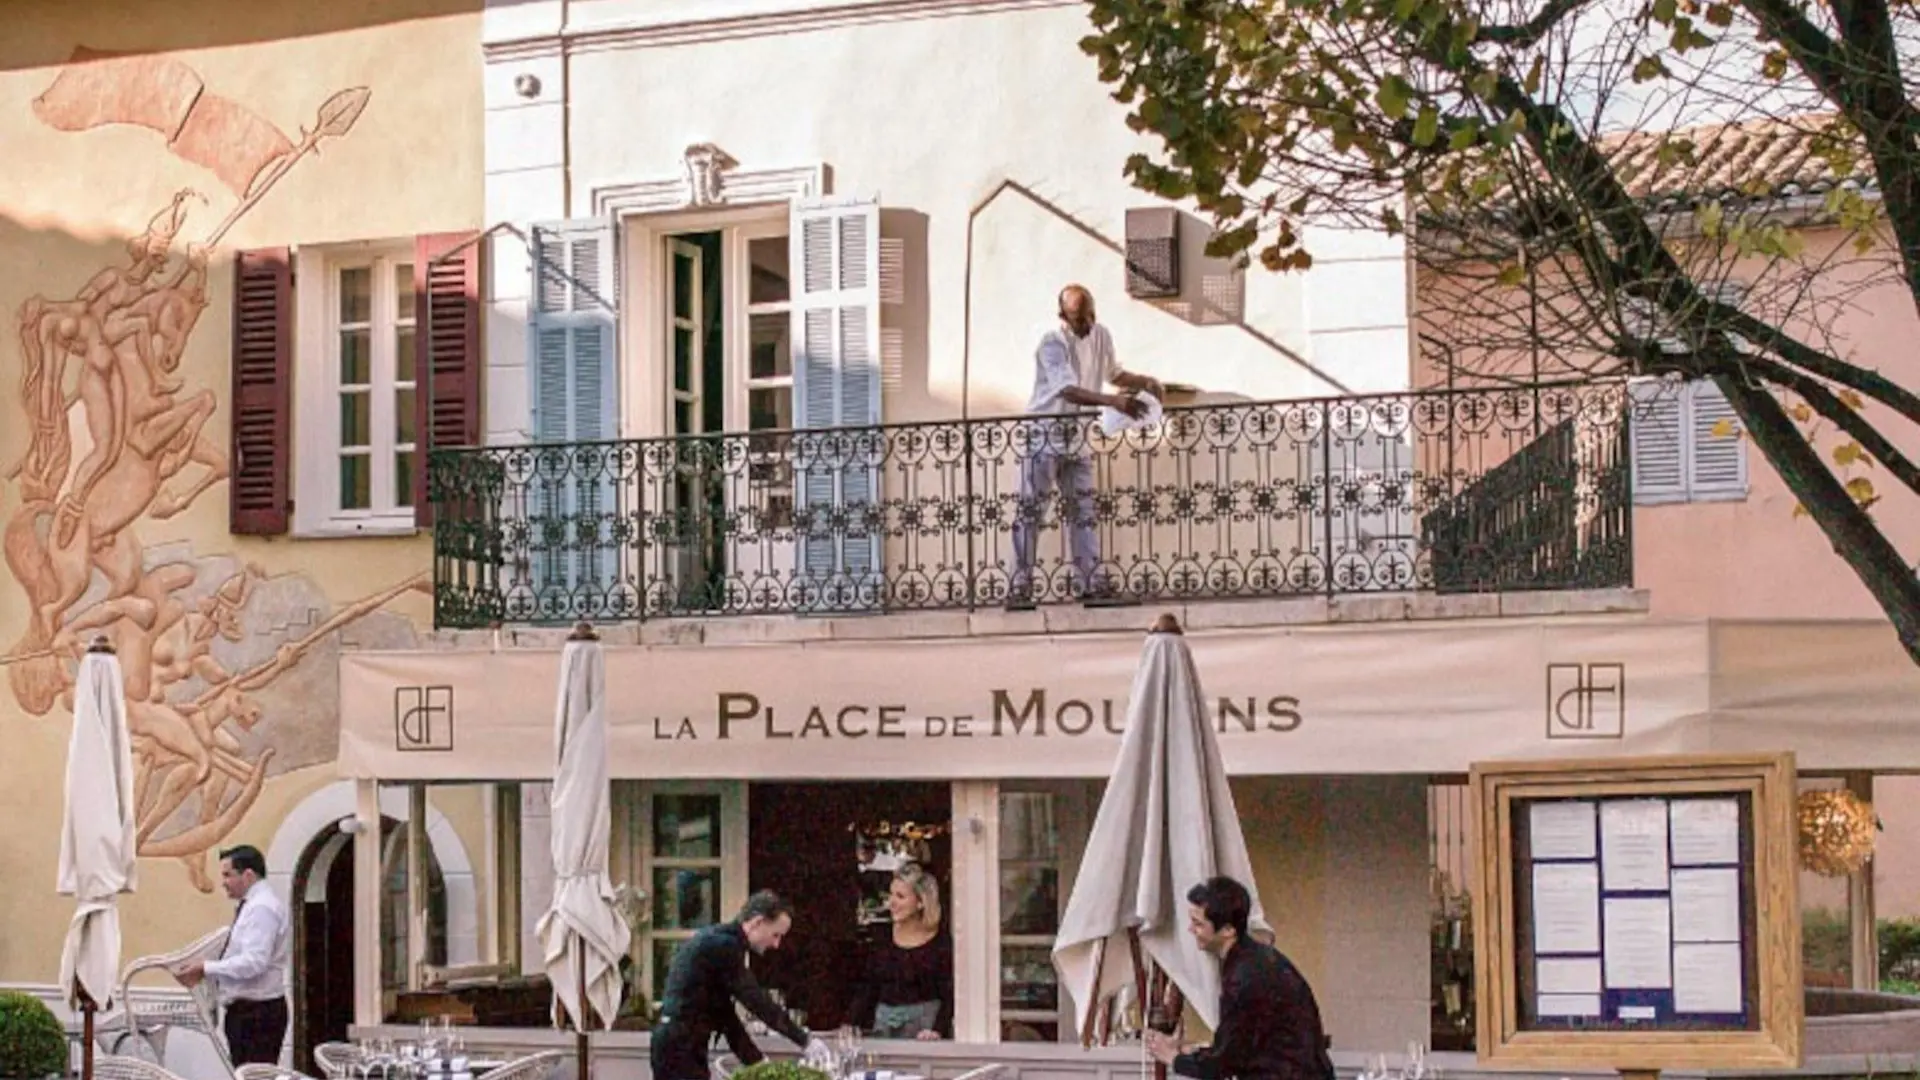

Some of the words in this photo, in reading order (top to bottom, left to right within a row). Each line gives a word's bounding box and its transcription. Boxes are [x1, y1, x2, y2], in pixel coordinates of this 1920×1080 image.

[653, 717, 697, 740] LA
[717, 692, 906, 740] PLACE
[925, 716, 973, 737] DE
[991, 688, 1302, 737] MOUNS
